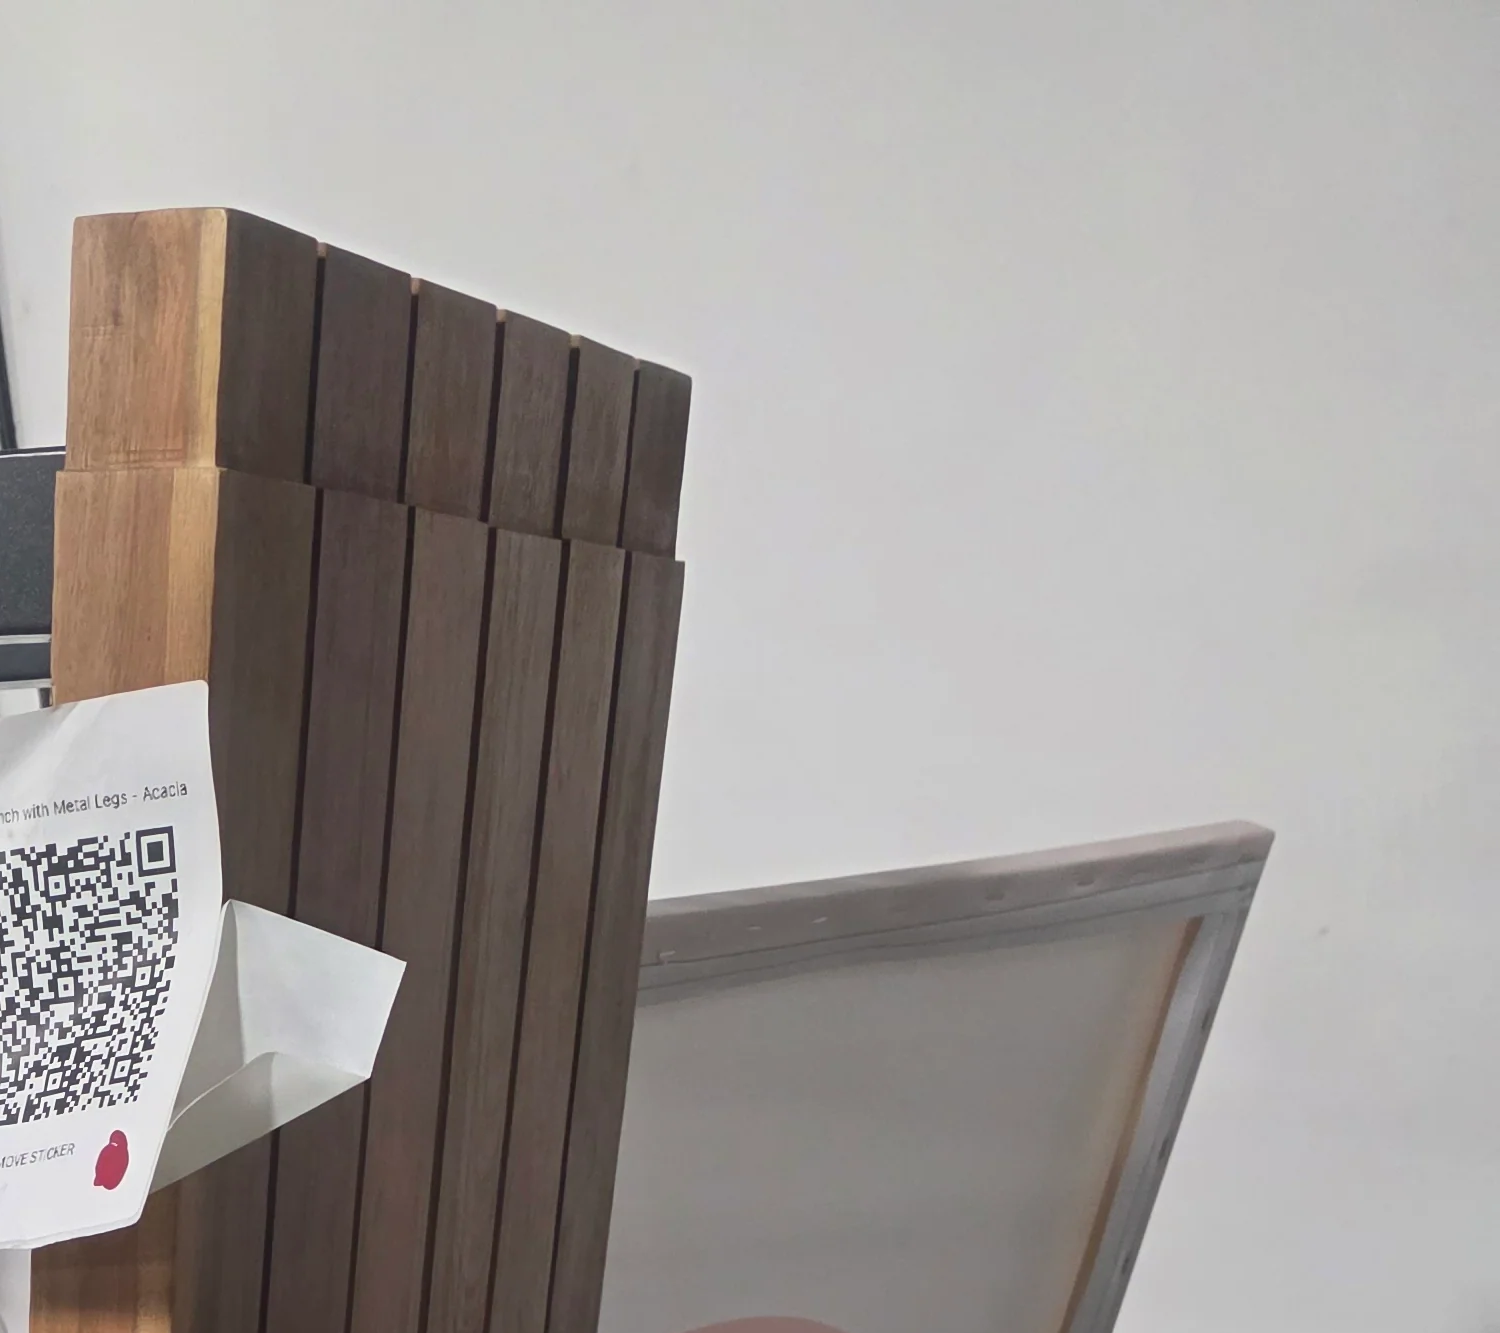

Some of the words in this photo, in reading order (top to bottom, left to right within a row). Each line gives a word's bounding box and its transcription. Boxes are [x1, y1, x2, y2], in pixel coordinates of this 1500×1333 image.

[22, 803, 49, 821] with
[53, 796, 91, 816] Metal
[94, 792, 128, 810] Legs
[143, 781, 188, 802] Acacia
[29, 1143, 76, 1163] STICKER
